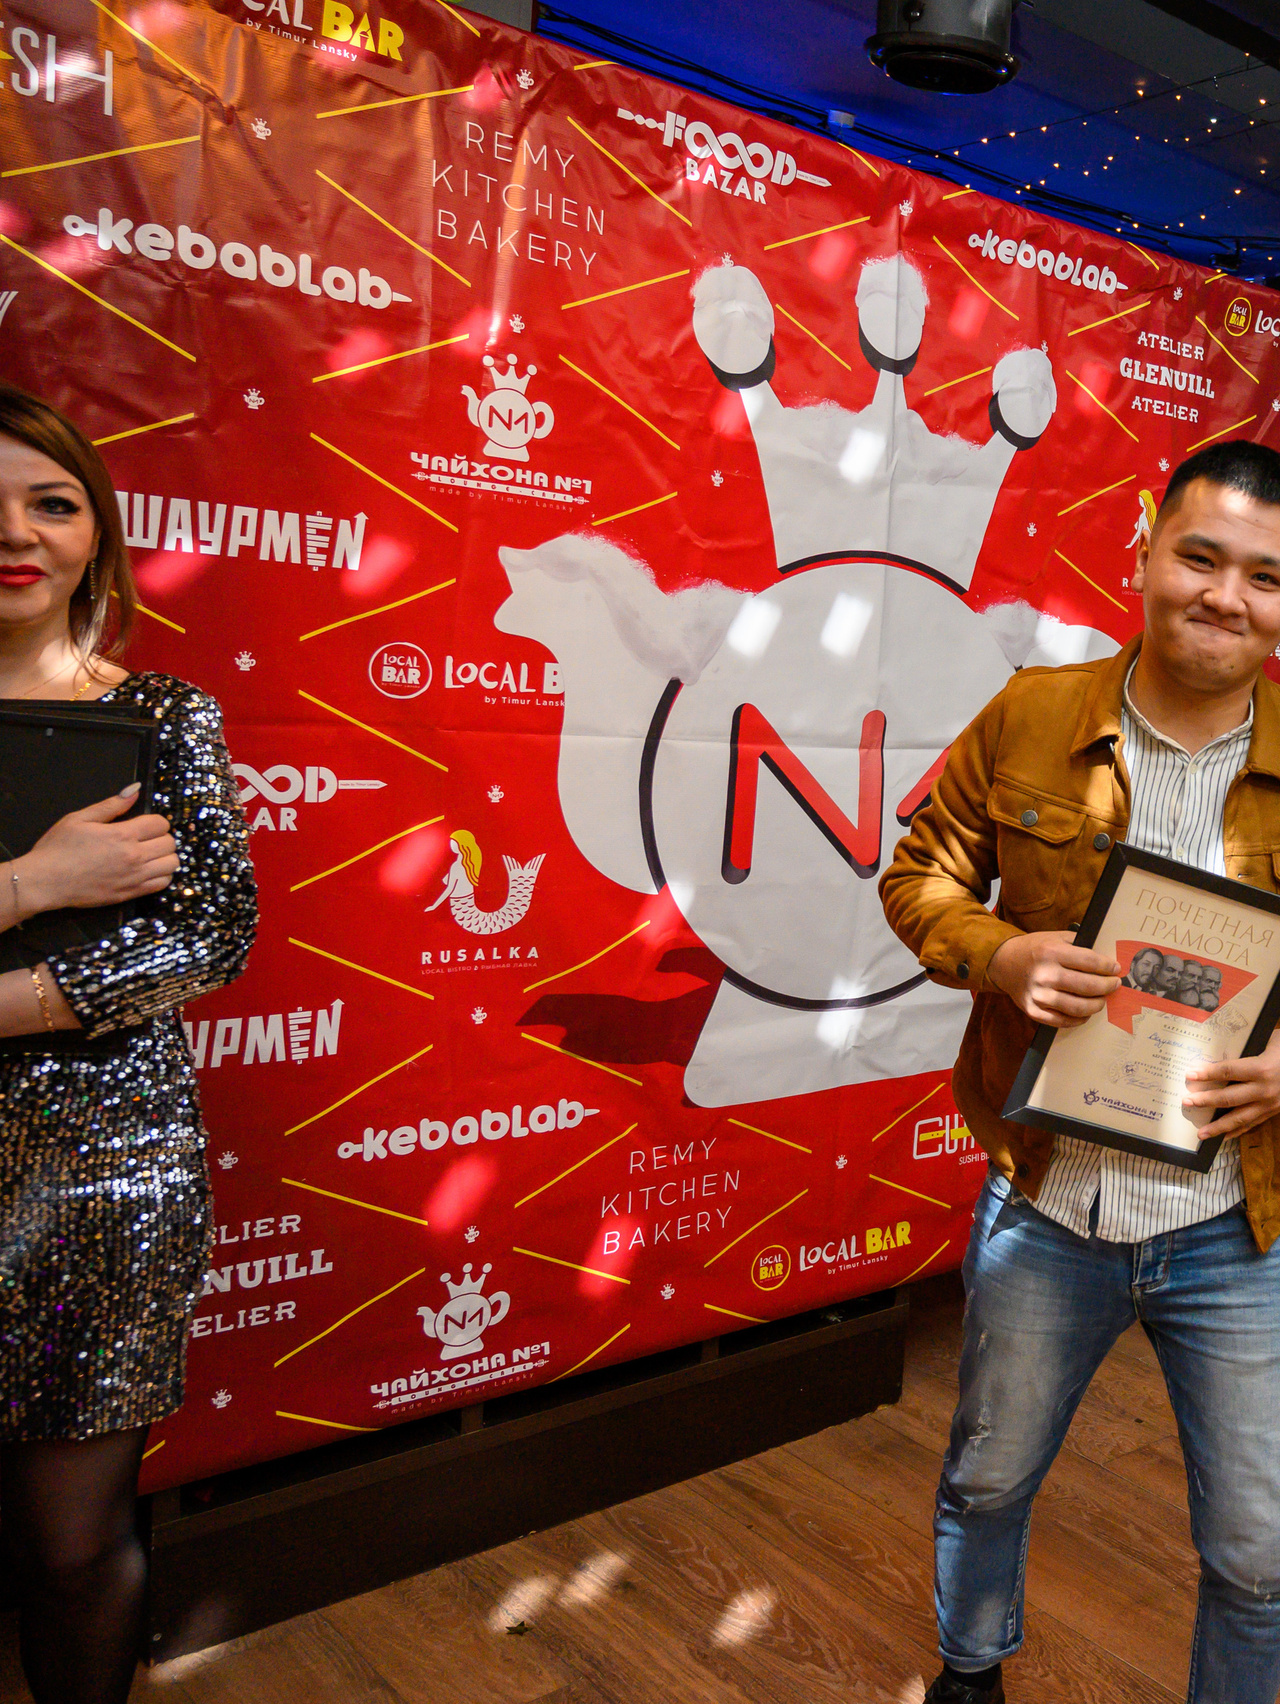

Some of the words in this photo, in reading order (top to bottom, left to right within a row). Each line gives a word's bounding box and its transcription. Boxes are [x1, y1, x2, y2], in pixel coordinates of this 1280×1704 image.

[246, 18, 262, 31] by
[269, 25, 307, 45] Timur
[312, 40, 358, 61] Lansky
[321, 0, 404, 61] BAR
[0, 20, 113, 116] SH
[465, 121, 574, 179] REMY
[431, 159, 604, 236] KITCHEN
[686, 157, 767, 205] BAZAR
[437, 209, 597, 277] BAKERY
[1229, 312, 1247, 328] BAR
[1137, 331, 1205, 361] ATELIER
[1119, 357, 1215, 399] GLENUILL
[1131, 395, 1199, 423] ATELIER
[410, 452, 549, 488] ЧАЙХОНА
[554, 475, 592, 494] №1
[429, 486, 461, 496] made
[468, 491, 483, 500] by
[492, 494, 528, 505] Timur
[536, 501, 574, 513] Lansky
[381, 665, 421, 685] BAR
[383, 652, 421, 668] LOCAL
[444, 655, 536, 694] LOCAL
[484, 696, 497, 705] by
[502, 696, 531, 705] Timur
[535, 698, 565, 707] Lansk
[1135, 888, 1275, 949] ПОЧЕТНАЯ
[421, 946, 540, 966] RUSALKA
[1139, 915, 1251, 967] ГРАМОТА
[629, 1137, 717, 1174] REMY
[959, 1153, 979, 1165] SUSHI
[600, 1169, 741, 1218] KITCHEN
[602, 1205, 732, 1255] BAKERY
[800, 1234, 863, 1272] LOCAL
[865, 1220, 912, 1255] BAR
[759, 1262, 784, 1280] BAR
[760, 1253, 783, 1267] LOCAL
[839, 1261, 860, 1271] Timur
[862, 1255, 888, 1266] Lansky
[370, 1353, 506, 1397] ЧАЙХОНА
[391, 1402, 422, 1414] made
[452, 1385, 486, 1397] Timur
[494, 1372, 534, 1387] Lansky
